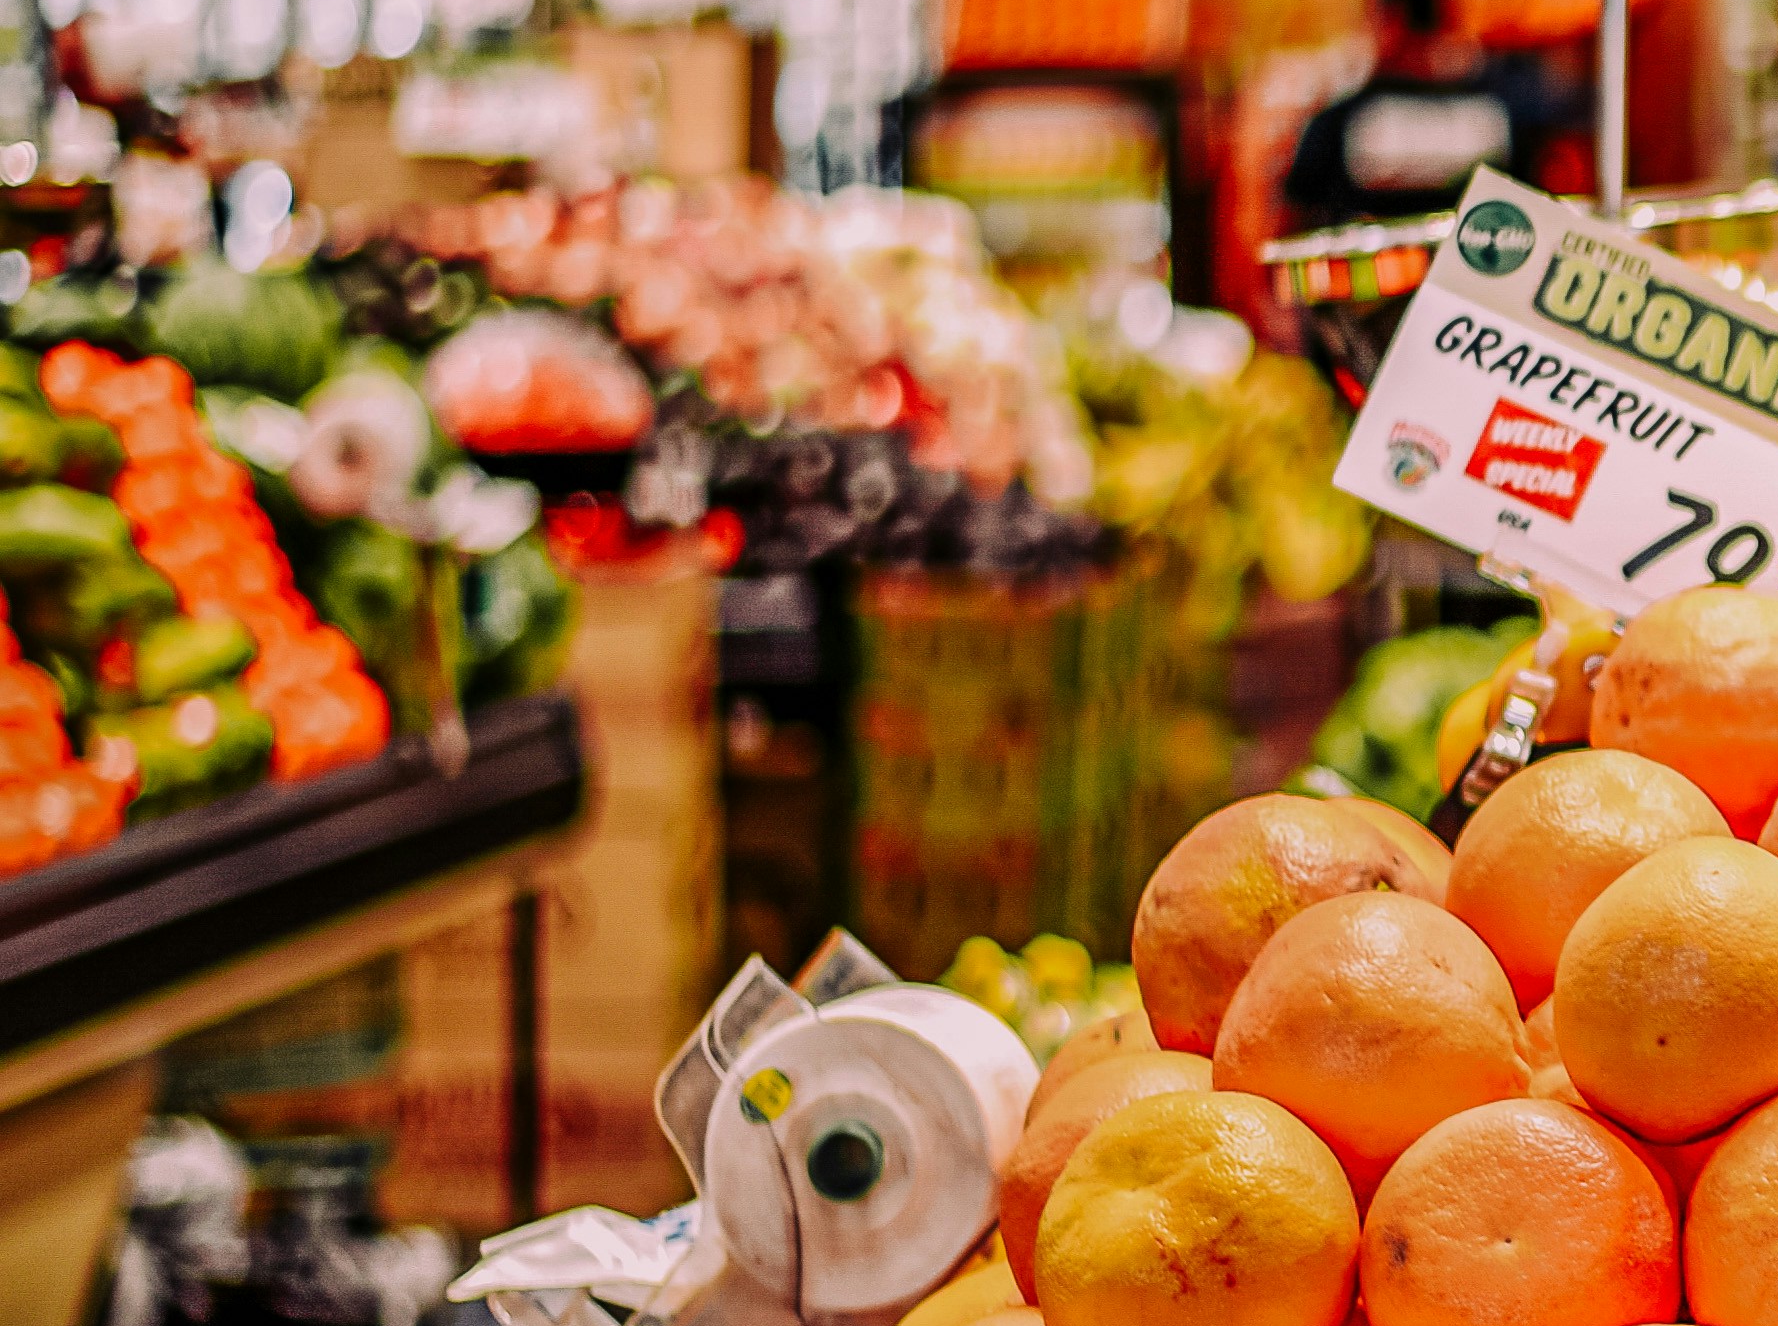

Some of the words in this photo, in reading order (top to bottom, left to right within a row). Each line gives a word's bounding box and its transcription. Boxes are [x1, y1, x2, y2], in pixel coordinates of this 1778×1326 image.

[1435, 314, 1716, 463] GRAPEFRUIT
[1490, 416, 1584, 454] WEEKLY
[1483, 460, 1578, 500] SPECIAL
